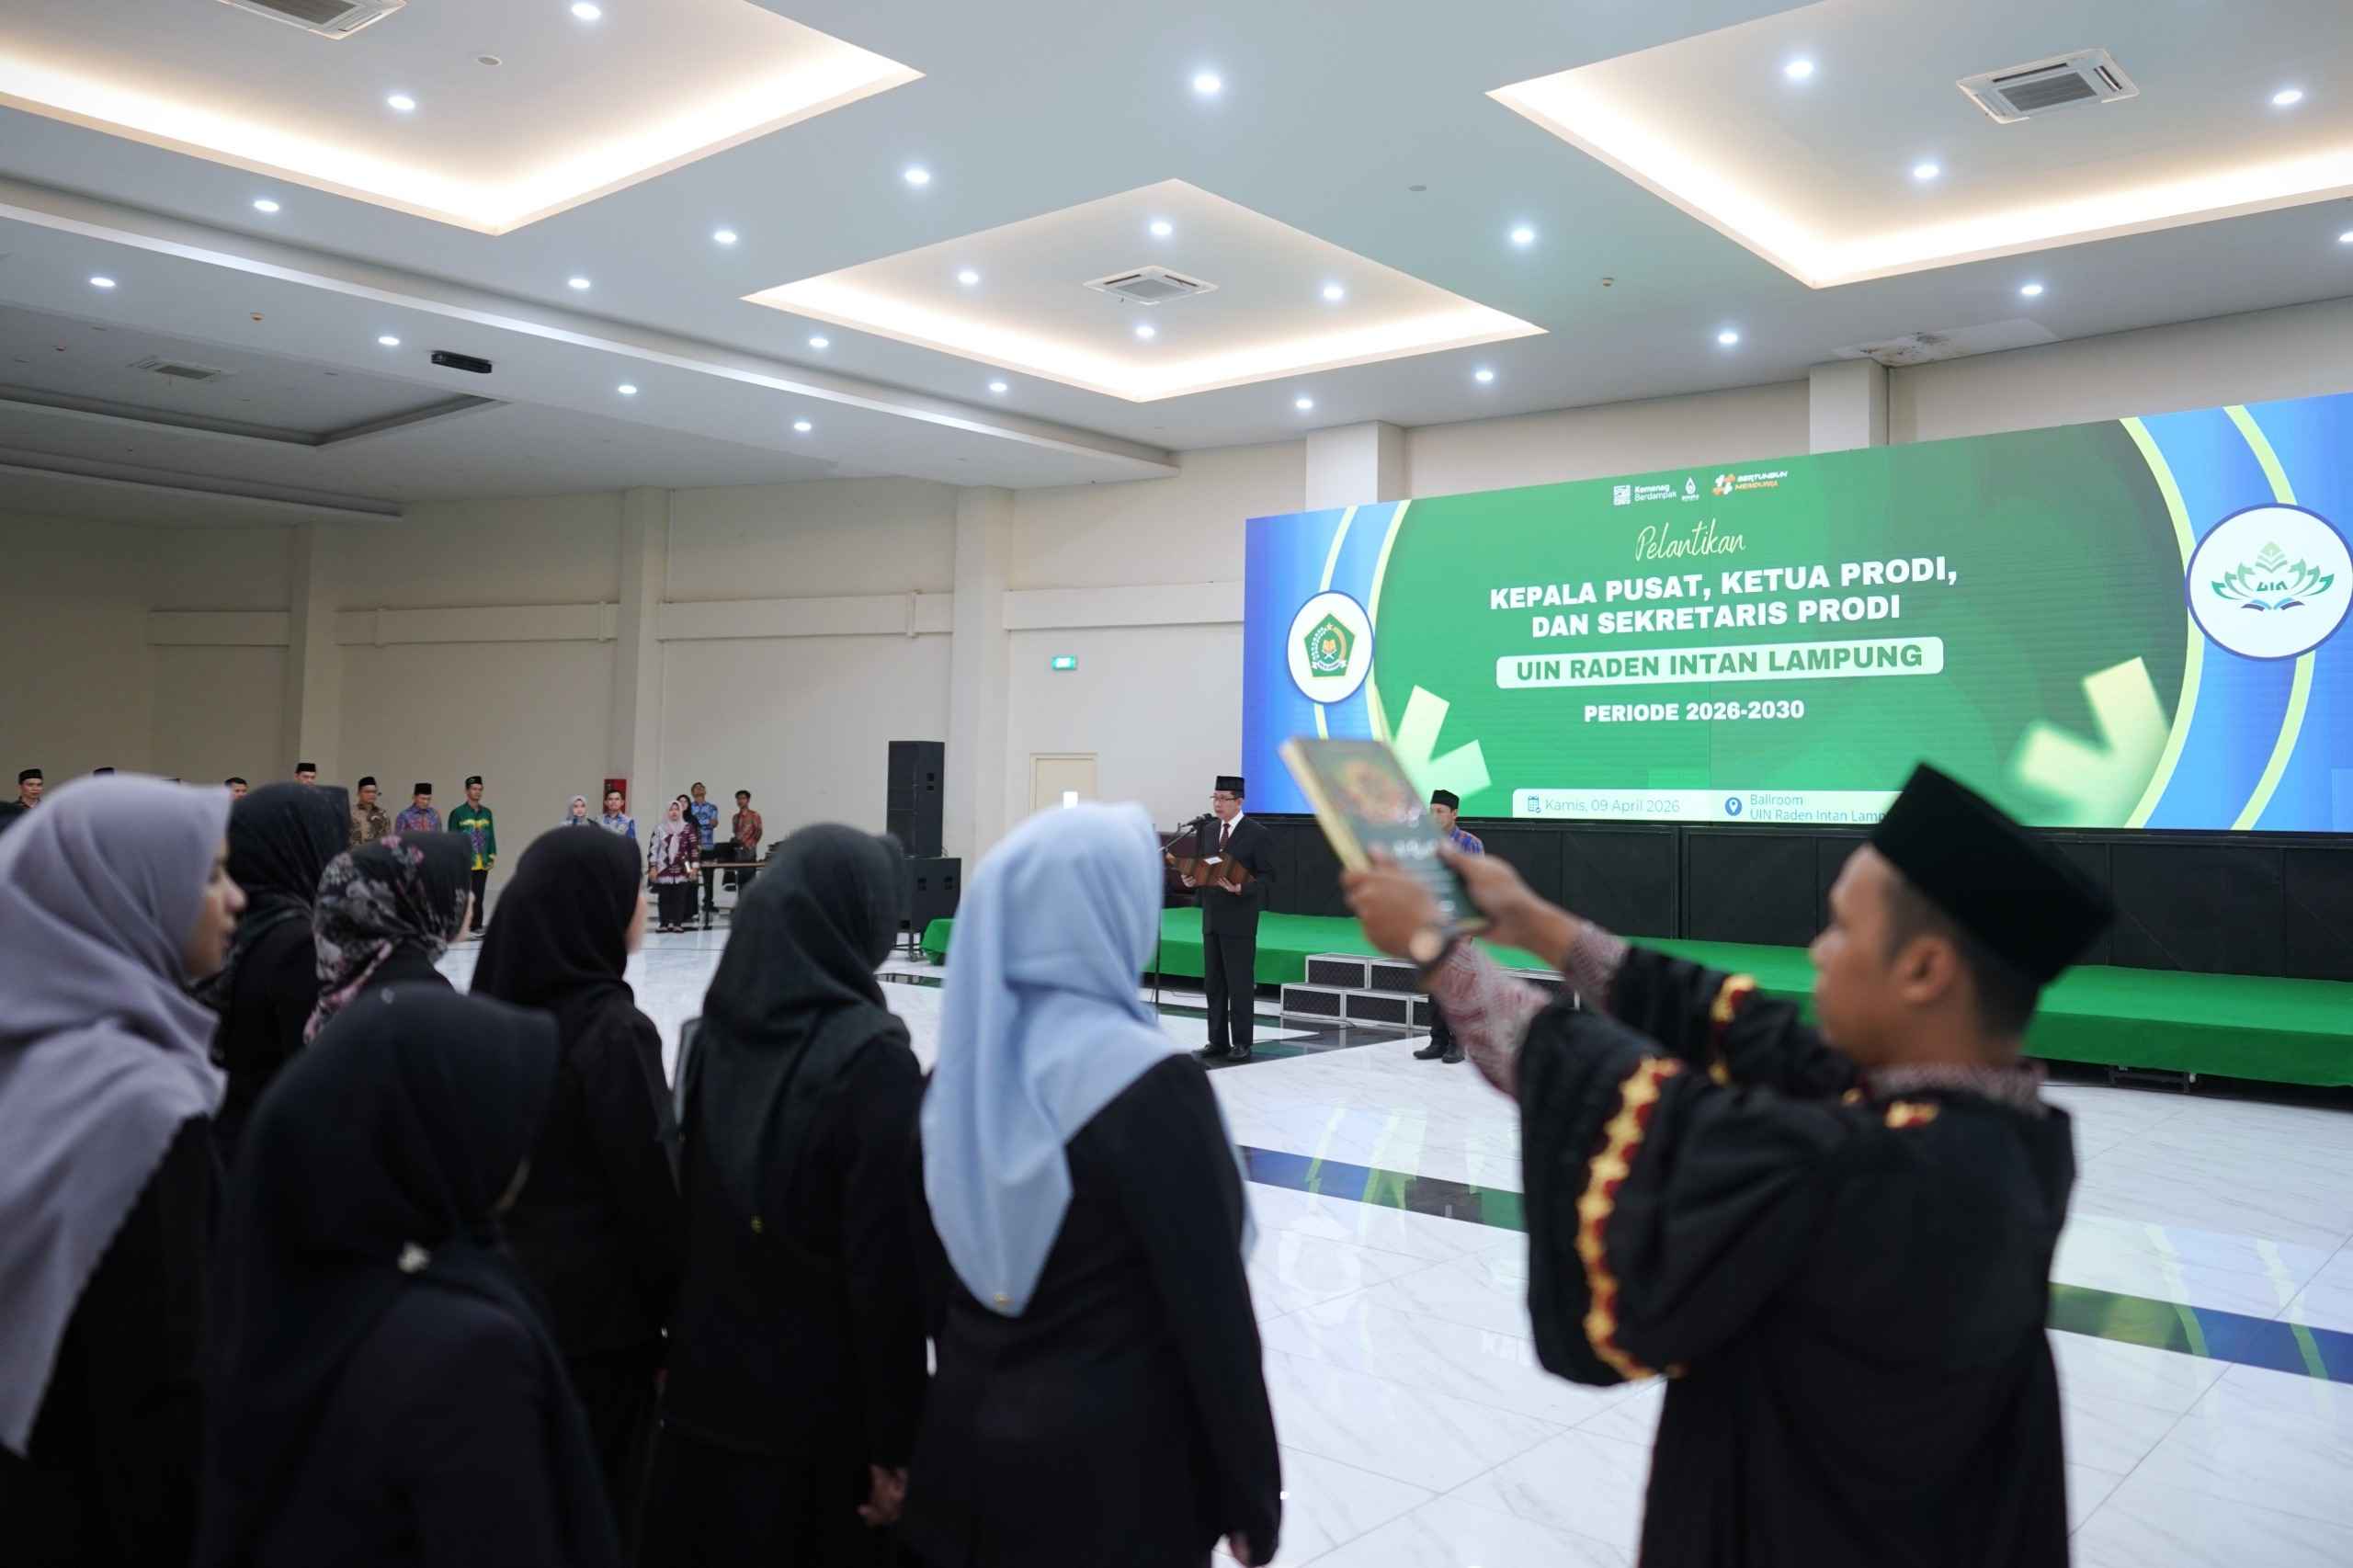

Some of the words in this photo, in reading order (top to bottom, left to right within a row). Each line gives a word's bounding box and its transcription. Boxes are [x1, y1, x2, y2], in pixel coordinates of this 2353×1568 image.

[1634, 484, 1670, 494] Kemenag
[1634, 491, 1677, 501] Berdampak
[1634, 517, 1745, 562] Pelantikan
[1490, 582, 1597, 609] KEPALA
[1606, 574, 1711, 602] PUSAT,
[1721, 564, 1831, 595] KETUA
[1840, 556, 1957, 586] PRODI,
[1532, 613, 1588, 638] DAN
[1597, 601, 1788, 634] SEKRETARIS
[1798, 595, 1900, 623] PRODI
[1517, 660, 1561, 681] UIN
[1570, 656, 1659, 679] RADEN
[1670, 652, 1757, 676] INTAN
[1768, 644, 1923, 672] LAMPUNG
[1584, 703, 1680, 722] PERIODE
[1686, 699, 1805, 722] 2026-2030
[1545, 799, 1588, 812] Kamis,
[1591, 799, 1608, 812] 09
[1611, 799, 1643, 814] April
[1646, 800, 1680, 812] 2026
[1750, 794, 1803, 806] Ballroom
[1750, 809, 1772, 821] UIN
[1775, 809, 1813, 821] Raden
[1816, 810, 1847, 822] Intan
[1851, 811, 1887, 824] Lamp
